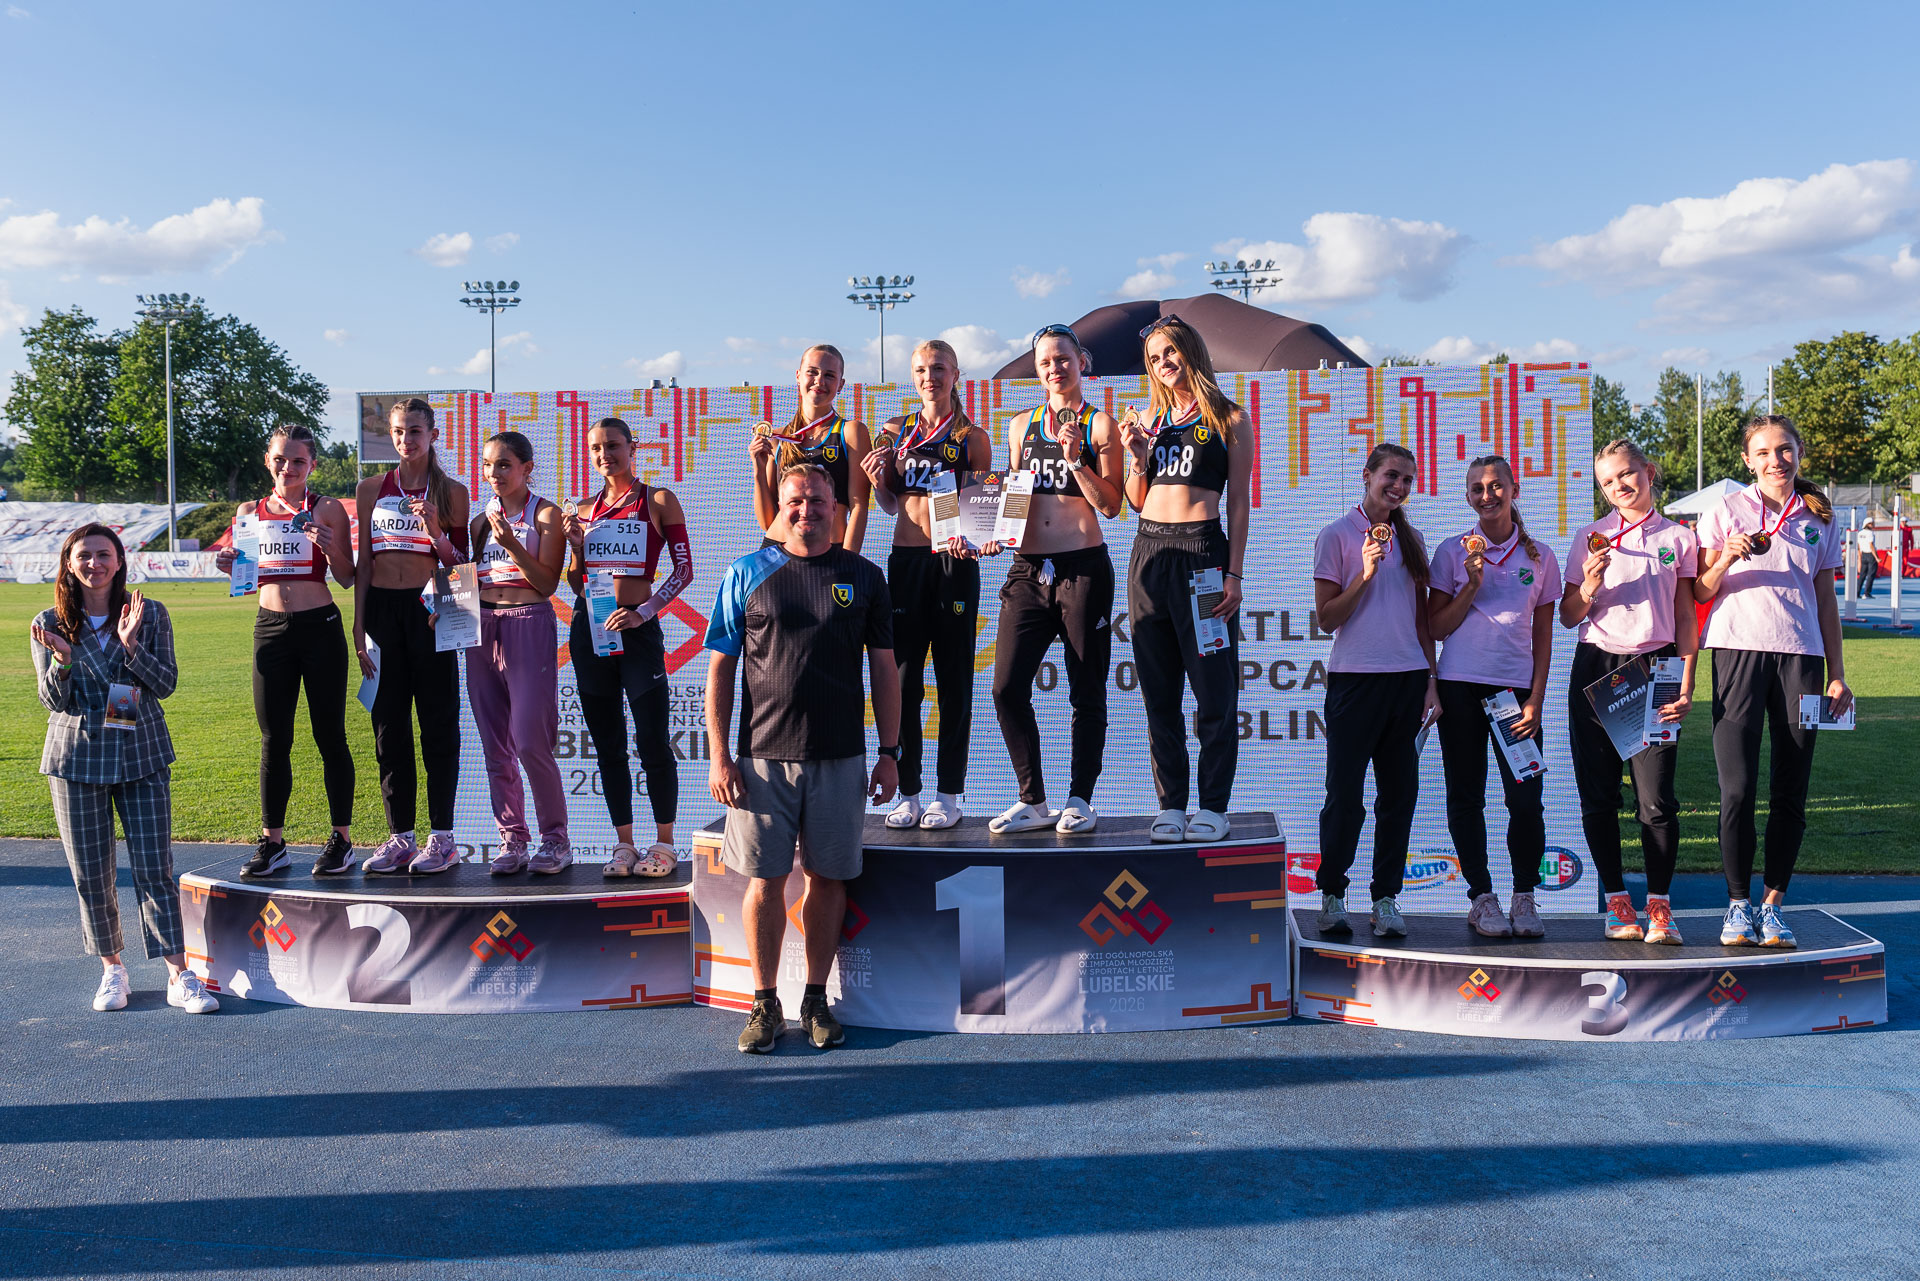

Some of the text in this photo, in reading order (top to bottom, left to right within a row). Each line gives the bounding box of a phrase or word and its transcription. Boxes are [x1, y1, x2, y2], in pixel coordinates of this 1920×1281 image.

[1155, 445, 1194, 477] 868
[905, 458, 942, 488] 821
[1030, 458, 1067, 489] 853
[970, 496, 1000, 504] DYPLO
[618, 523, 640, 534] 515
[1141, 522, 1173, 534] NIKE
[259, 542, 300, 555] TUREK
[588, 543, 639, 557] PĘKALA
[442, 592, 472, 602] DYPLOM
[1608, 684, 1646, 713] DYPLOM
[936, 866, 1006, 1015] 1
[346, 903, 411, 1005] 2
[1079, 950, 1174, 960] XXXII OGÓLNOPOLSKA
[1079, 958, 1174, 968] OLIMPIADA MŁODZIEŻY
[1138, 966, 1174, 974] LETNICH
[469, 982, 536, 994] LUBELSKIE
[1079, 974, 1175, 994] LUBELSKIE
[1110, 997, 1144, 1012] 2026
[1581, 971, 1628, 1036] 3
[1456, 1013, 1502, 1023] LUBELSKIE
[1706, 1016, 1748, 1026] LUBELSKIE
